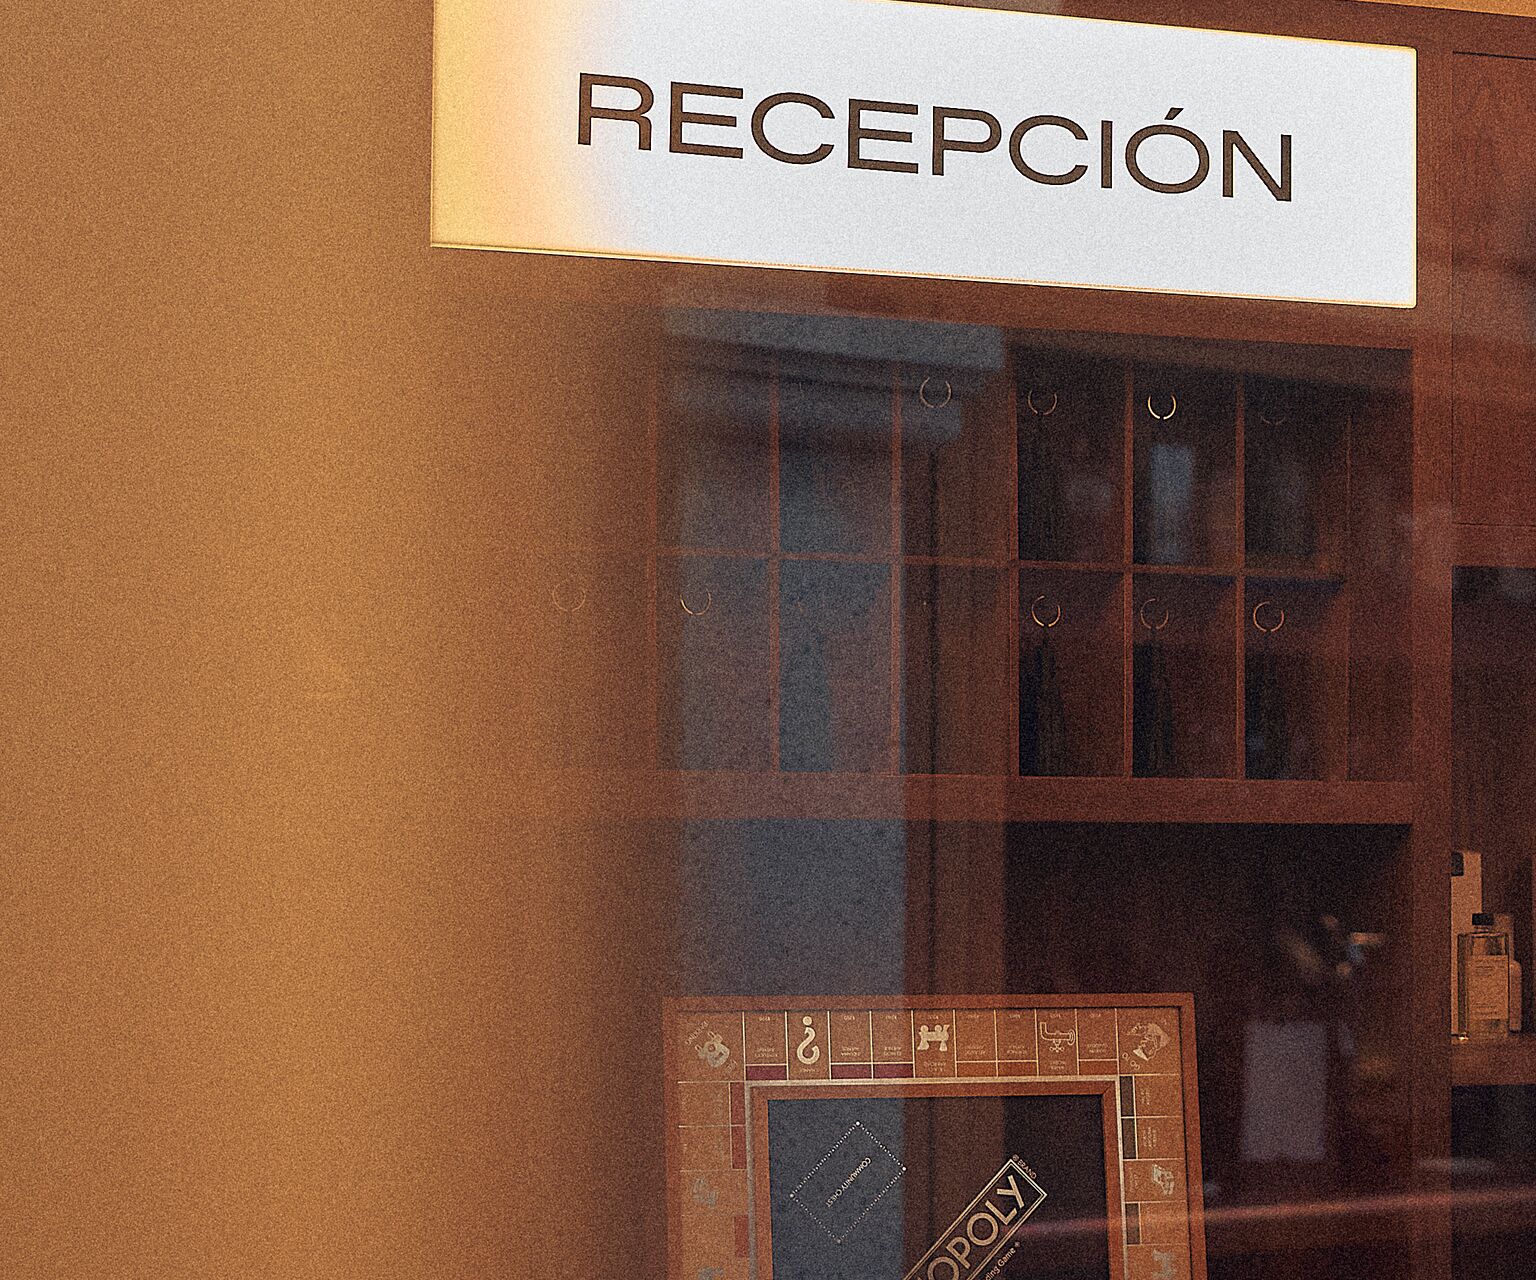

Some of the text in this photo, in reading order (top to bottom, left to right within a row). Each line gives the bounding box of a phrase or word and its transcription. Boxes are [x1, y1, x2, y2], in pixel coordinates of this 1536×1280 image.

[578, 72, 1293, 202] RECEPCIÓN
[825, 1157, 872, 1208] COMMUNITY CHEST
[997, 1247, 1016, 1268] Game
